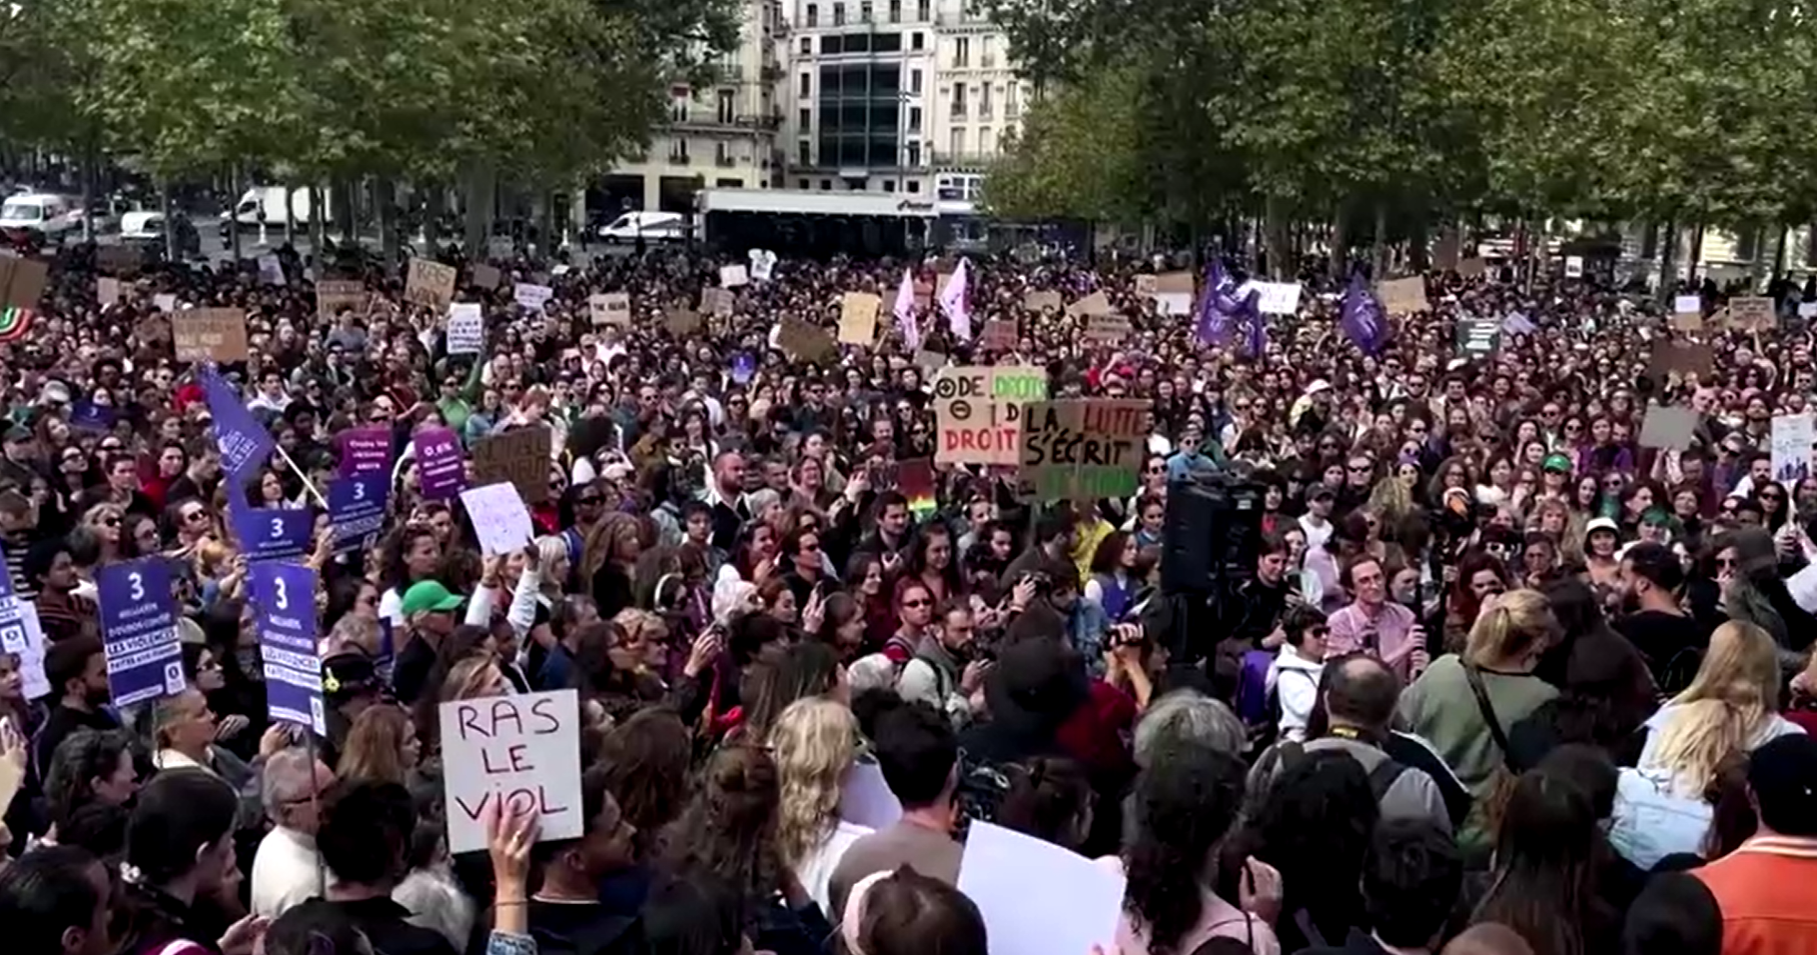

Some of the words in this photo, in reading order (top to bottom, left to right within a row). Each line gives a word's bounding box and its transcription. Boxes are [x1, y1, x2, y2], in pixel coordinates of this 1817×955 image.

[958, 376, 986, 397] DE
[1026, 406, 1060, 434] LA
[353, 482, 365, 500] 3
[271, 518, 284, 538] 3
[128, 572, 145, 600] 3
[274, 576, 289, 610] 3
[458, 698, 560, 741] RAS
[481, 744, 535, 774] LE
